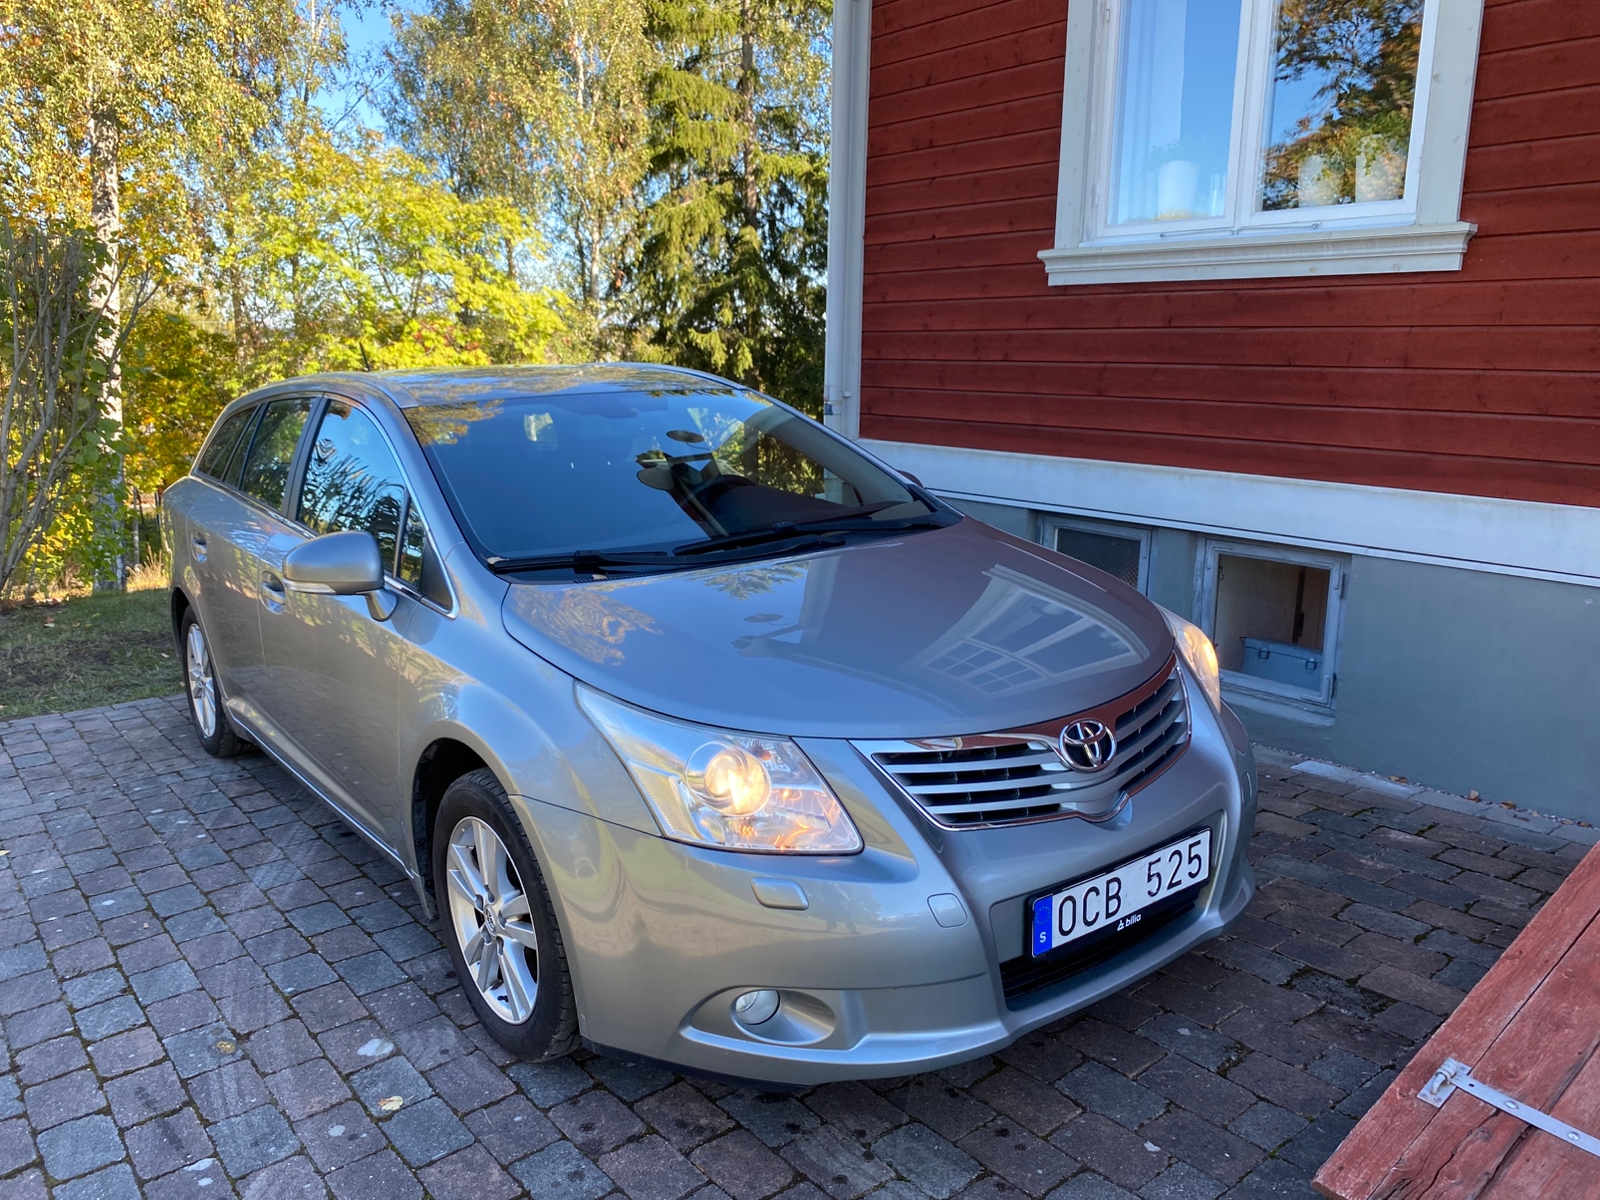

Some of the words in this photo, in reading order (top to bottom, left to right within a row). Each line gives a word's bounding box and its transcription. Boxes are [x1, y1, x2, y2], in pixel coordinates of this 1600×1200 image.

[1058, 877, 1122, 936] OCB
[1147, 840, 1202, 897] 525
[1125, 913, 1142, 927] bilia
[1039, 931, 1047, 944] S
